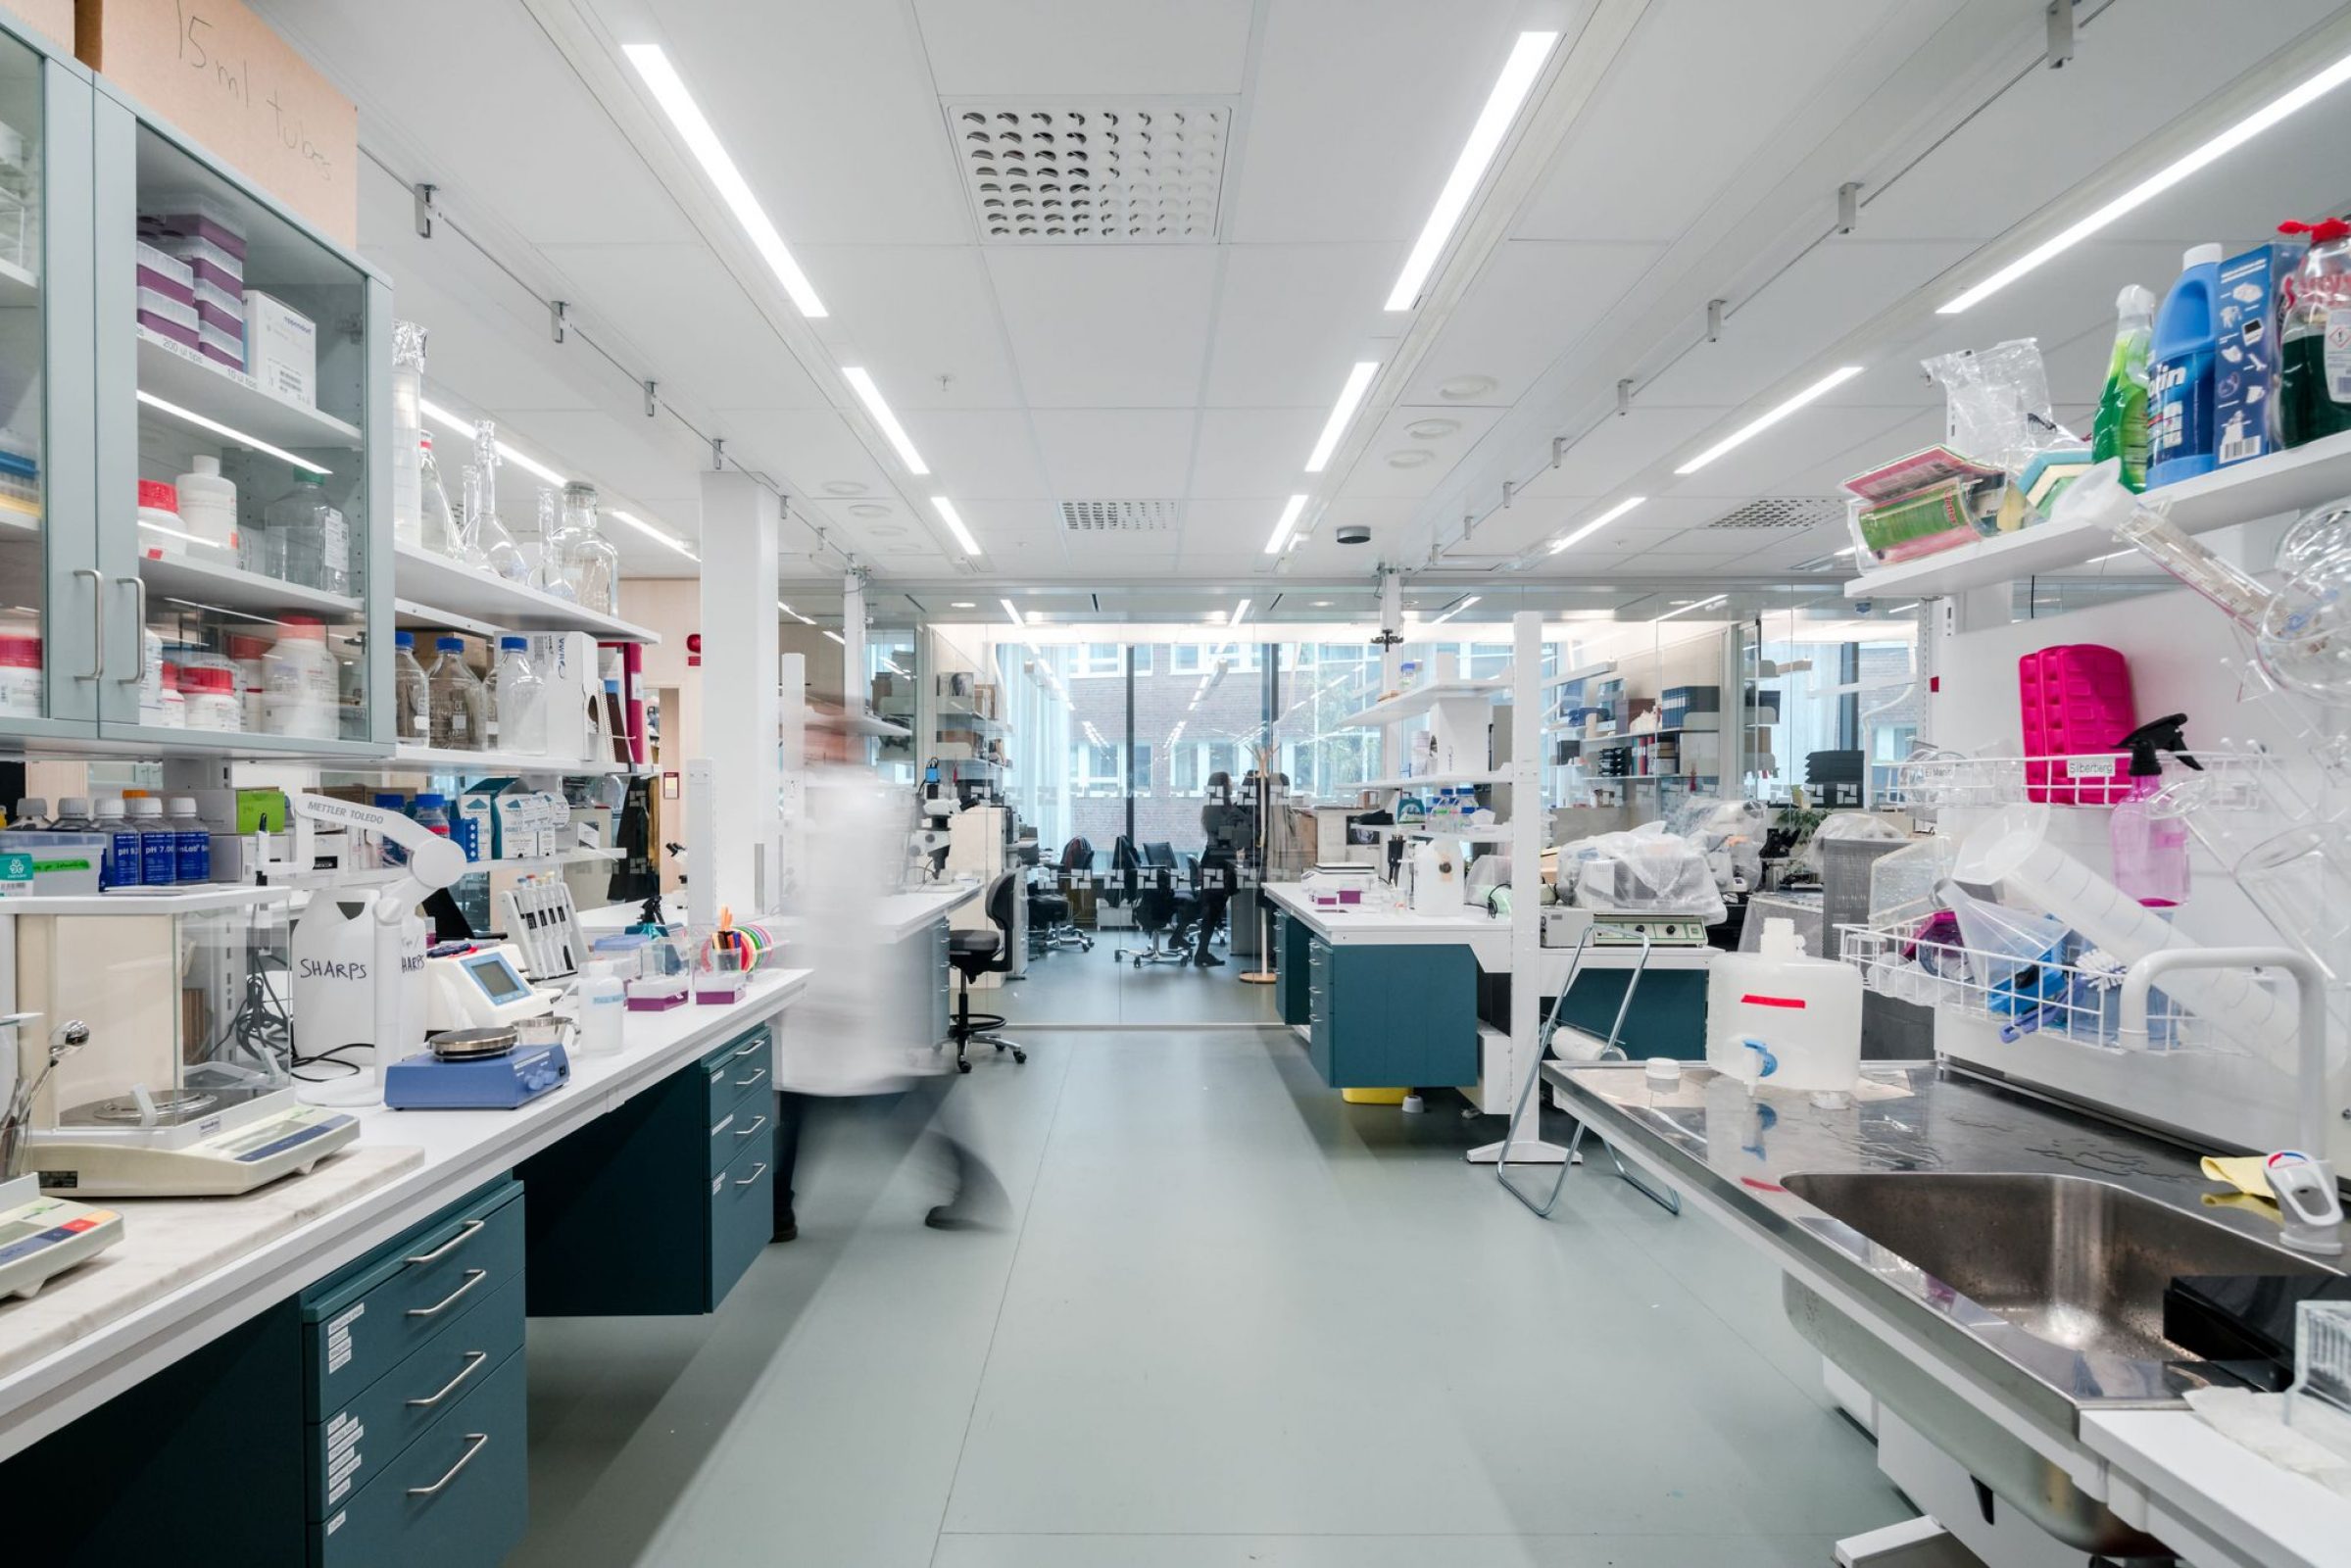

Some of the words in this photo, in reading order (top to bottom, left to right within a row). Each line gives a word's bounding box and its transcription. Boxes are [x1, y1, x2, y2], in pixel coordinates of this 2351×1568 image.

[266, 88, 332, 181] tubes
[308, 801, 348, 816] METTLER
[350, 809, 384, 824] TOLEDO
[300, 958, 367, 980] SHARPS
[401, 954, 425, 973] HARPS
